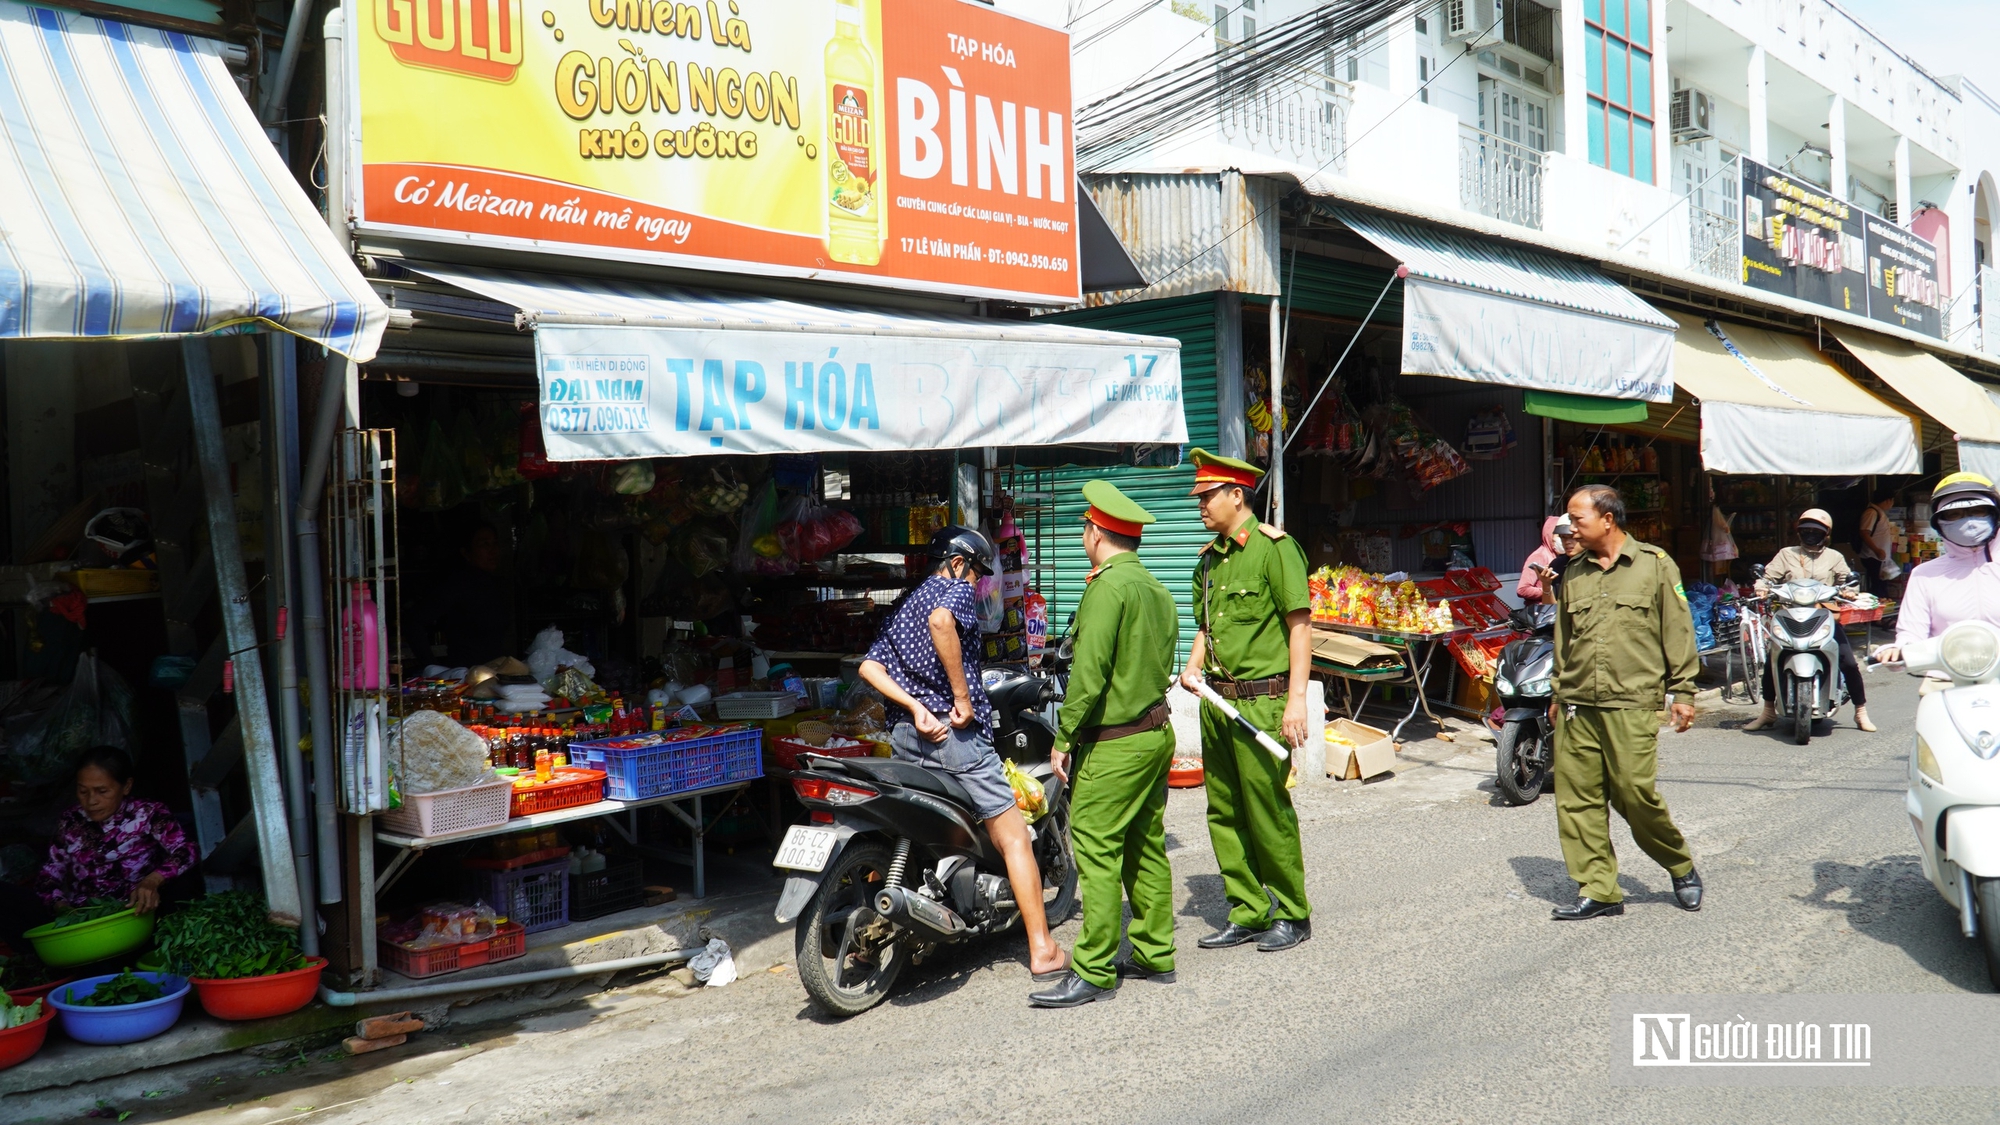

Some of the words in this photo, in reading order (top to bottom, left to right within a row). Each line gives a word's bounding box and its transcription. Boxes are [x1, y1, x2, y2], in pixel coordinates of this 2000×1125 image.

[947, 32, 979, 60] TẠP
[982, 41, 1017, 68] HÓA
[687, 62, 801, 130] NGON
[579, 121, 649, 159] KHÓ
[653, 121, 758, 159] CƯỠNG
[831, 113, 872, 148] GOLD
[896, 65, 1065, 204] BÌNH
[394, 175, 435, 205] Có
[434, 180, 533, 217] Meizan
[539, 196, 588, 226] nấu
[593, 207, 633, 230] mê
[635, 213, 692, 244] ngay
[897, 195, 926, 212] CHUYÊN
[927, 201, 947, 215] CUNG
[948, 203, 962, 217] CẤP
[963, 205, 976, 219] CÁC
[977, 208, 992, 224] LOẠI
[993, 211, 1005, 223] GIA
[1005, 213, 1013, 227] VỊ
[1017, 215, 1029, 227] BIA
[1033, 216, 1051, 231] NƯỚC
[1052, 222, 1068, 235] NGỌT
[901, 237, 914, 253] 17
[916, 236, 928, 255] LÊ
[930, 238, 951, 258] VĂN
[953, 242, 981, 262] PHẤN
[988, 248, 1005, 265] ĐT:
[1006, 251, 1068, 272] 0942.950.650
[586, 358, 607, 371] HIÊN
[609, 360, 618, 371] DI
[620, 358, 646, 373] ĐỘNG
[1123, 354, 1159, 378] 17
[549, 378, 591, 405] ĐẠI
[596, 379, 644, 401] NAM
[666, 357, 767, 447] TẠP
[783, 347, 880, 431] HÓA
[1105, 381, 1118, 402] LÊ
[1121, 381, 1142, 402] VĂN
[549, 406, 652, 432] 0377.090.714
[791, 829, 829, 849] 86-C2
[780, 847, 825, 867] 100.39
